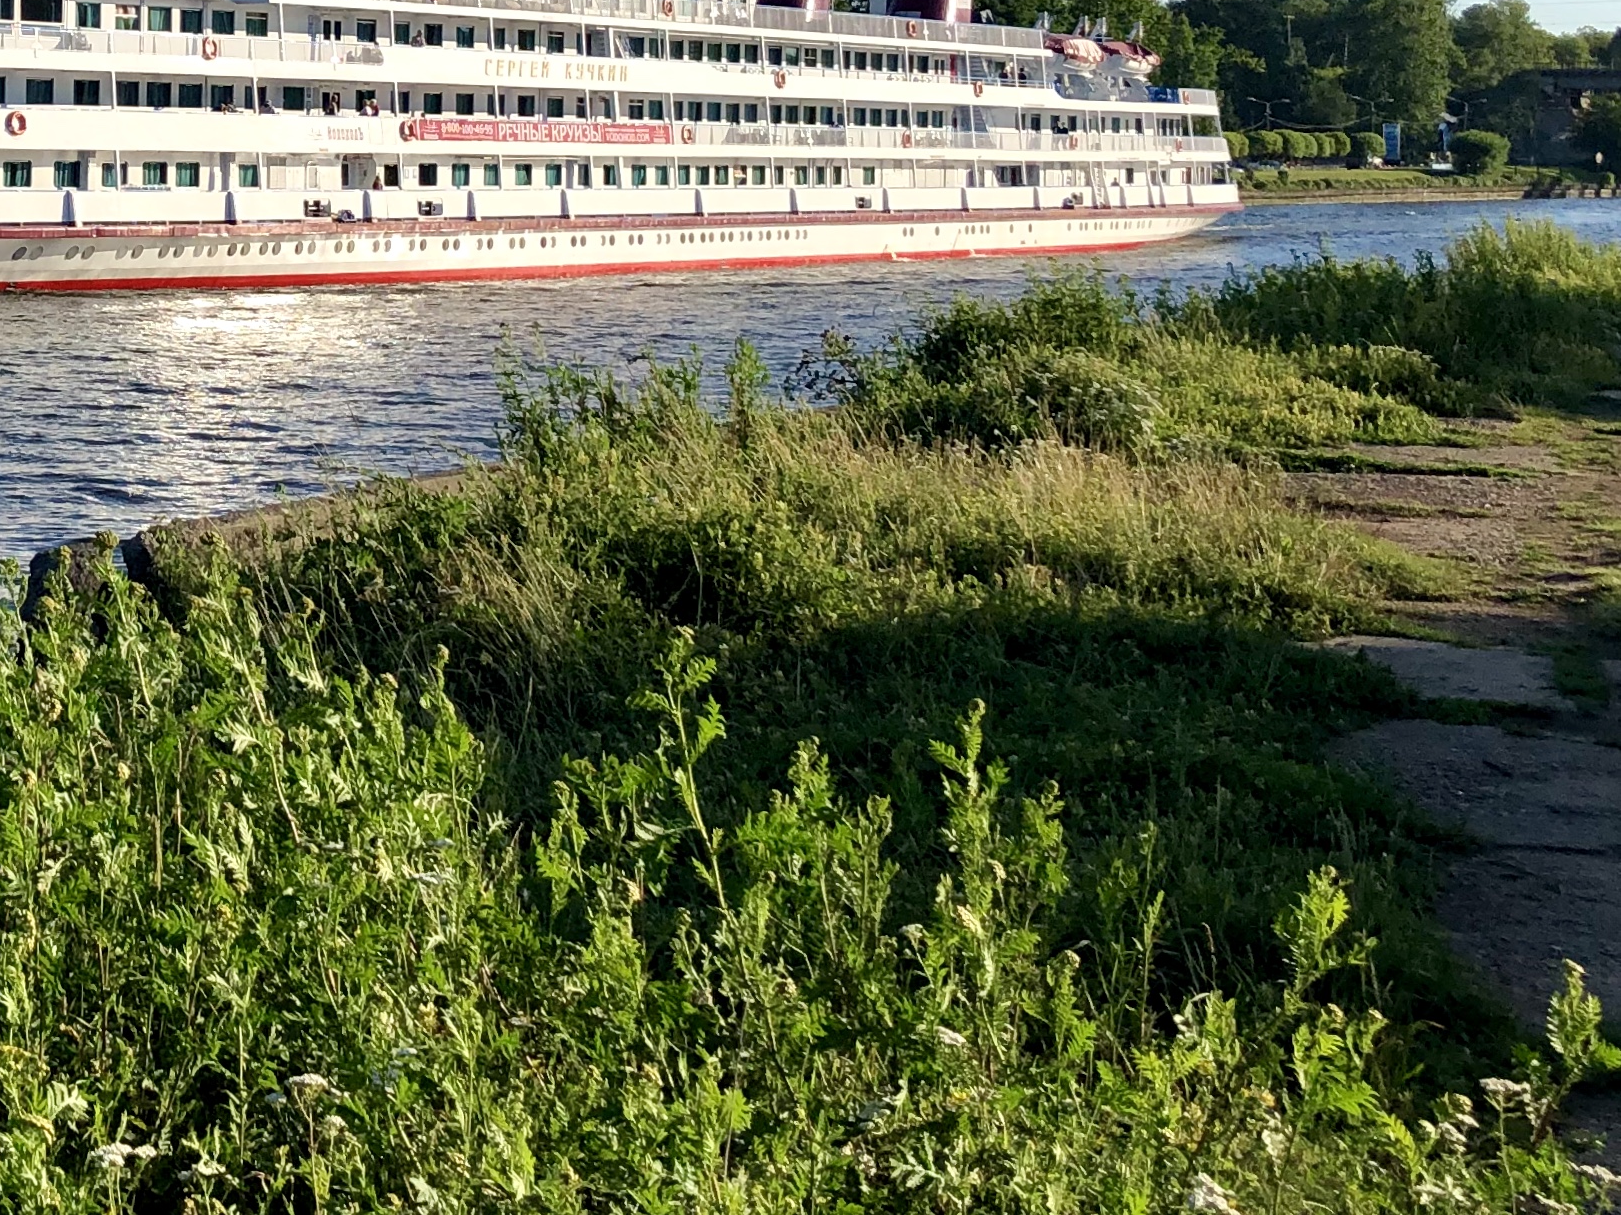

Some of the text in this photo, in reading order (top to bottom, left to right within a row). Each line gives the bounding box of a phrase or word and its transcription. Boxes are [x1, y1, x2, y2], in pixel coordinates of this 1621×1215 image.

[484, 57, 628, 82] СЕРГЕЙ КУЧКИН
[498, 123, 603, 142] РЕЧНЫЕ КРУИЗЫ
